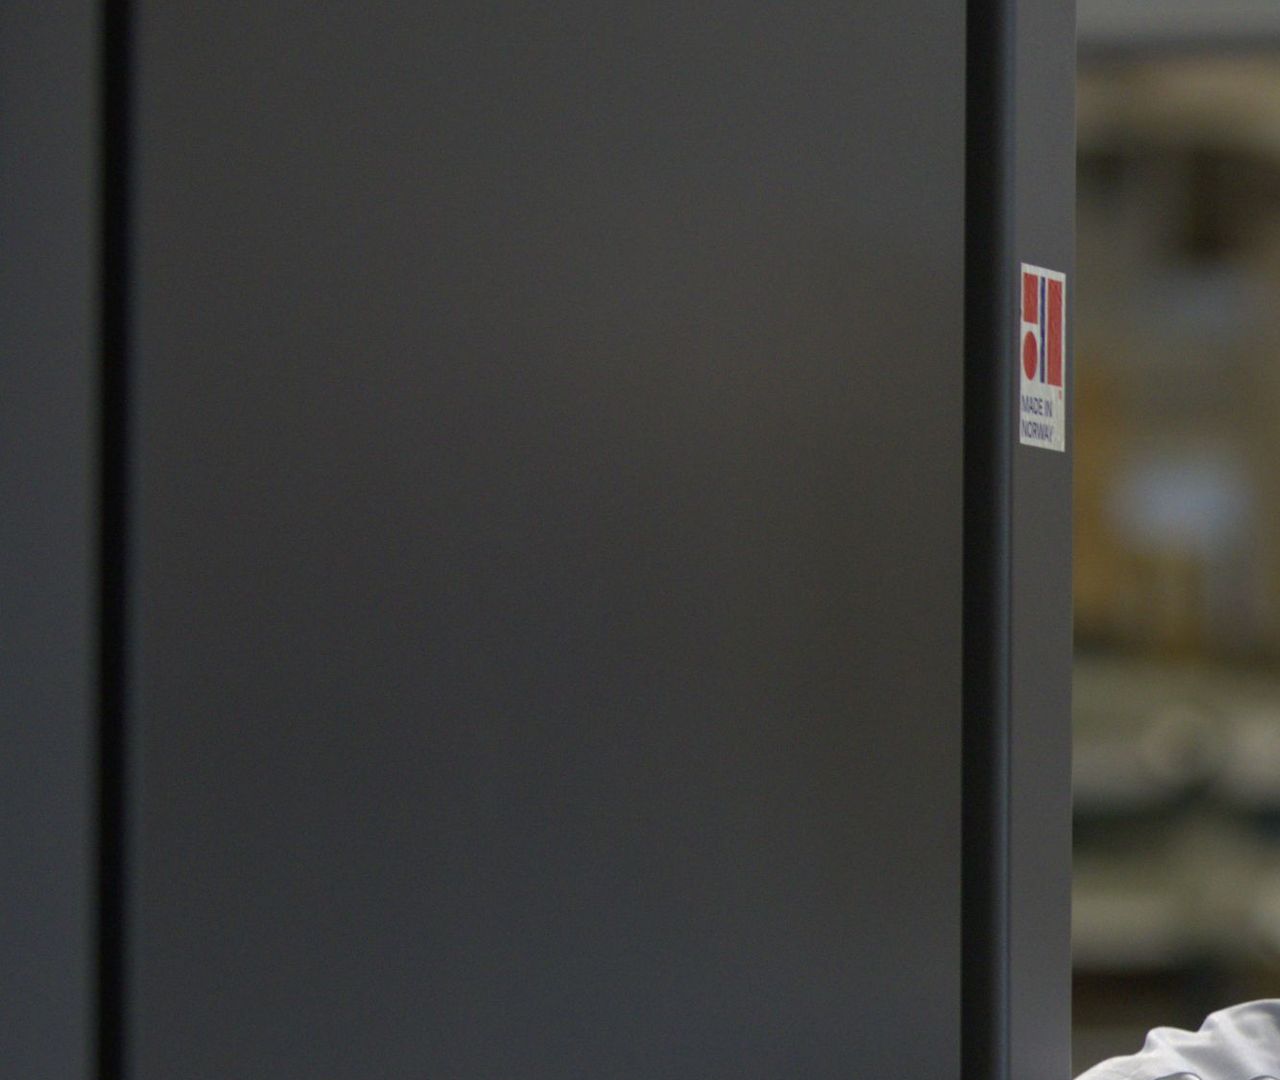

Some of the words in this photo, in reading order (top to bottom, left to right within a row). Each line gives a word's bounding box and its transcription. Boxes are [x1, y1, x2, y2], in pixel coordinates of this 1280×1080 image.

[1021, 395, 1043, 416] MADE
[1045, 400, 1053, 417] IN
[1022, 419, 1055, 443] NORWAY
